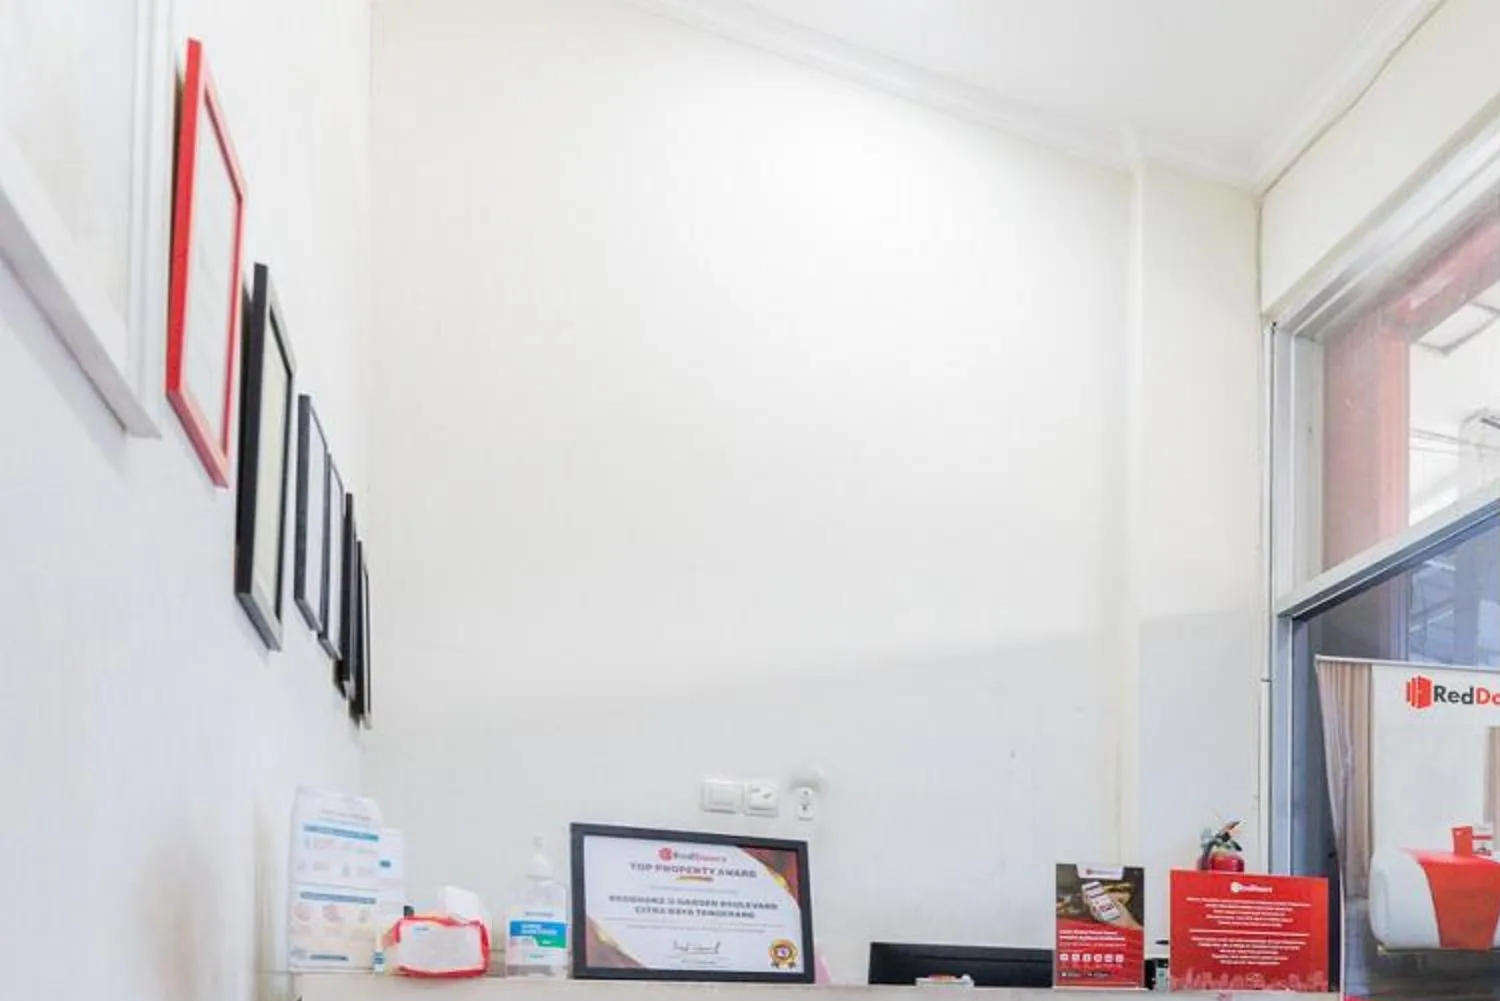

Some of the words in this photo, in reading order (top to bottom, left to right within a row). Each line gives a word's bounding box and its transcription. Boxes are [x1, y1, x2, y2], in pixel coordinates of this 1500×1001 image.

[630, 862, 652, 872] TOP
[655, 864, 715, 876] PROPERTY
[717, 868, 757, 878] AWARD
